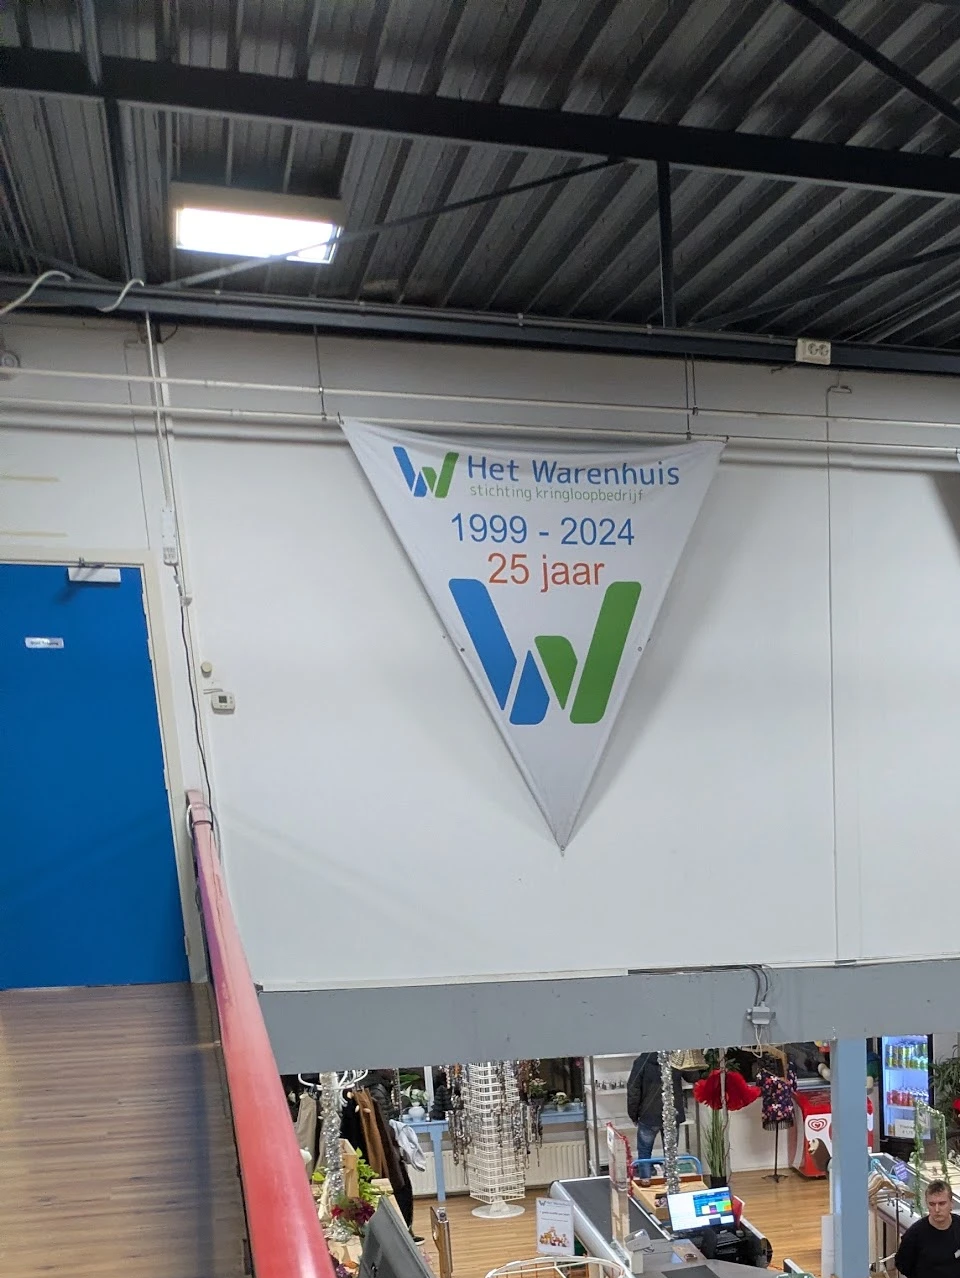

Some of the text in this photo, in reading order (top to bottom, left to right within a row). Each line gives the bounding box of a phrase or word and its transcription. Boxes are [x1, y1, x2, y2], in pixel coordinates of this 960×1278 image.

[467, 456, 680, 486] Het Warenhuis
[470, 484, 644, 504] stichting kringloopbedrijf
[451, 513, 528, 544] 1999
[560, 518, 635, 546] 2024
[488, 553, 605, 593] 25 jaar
